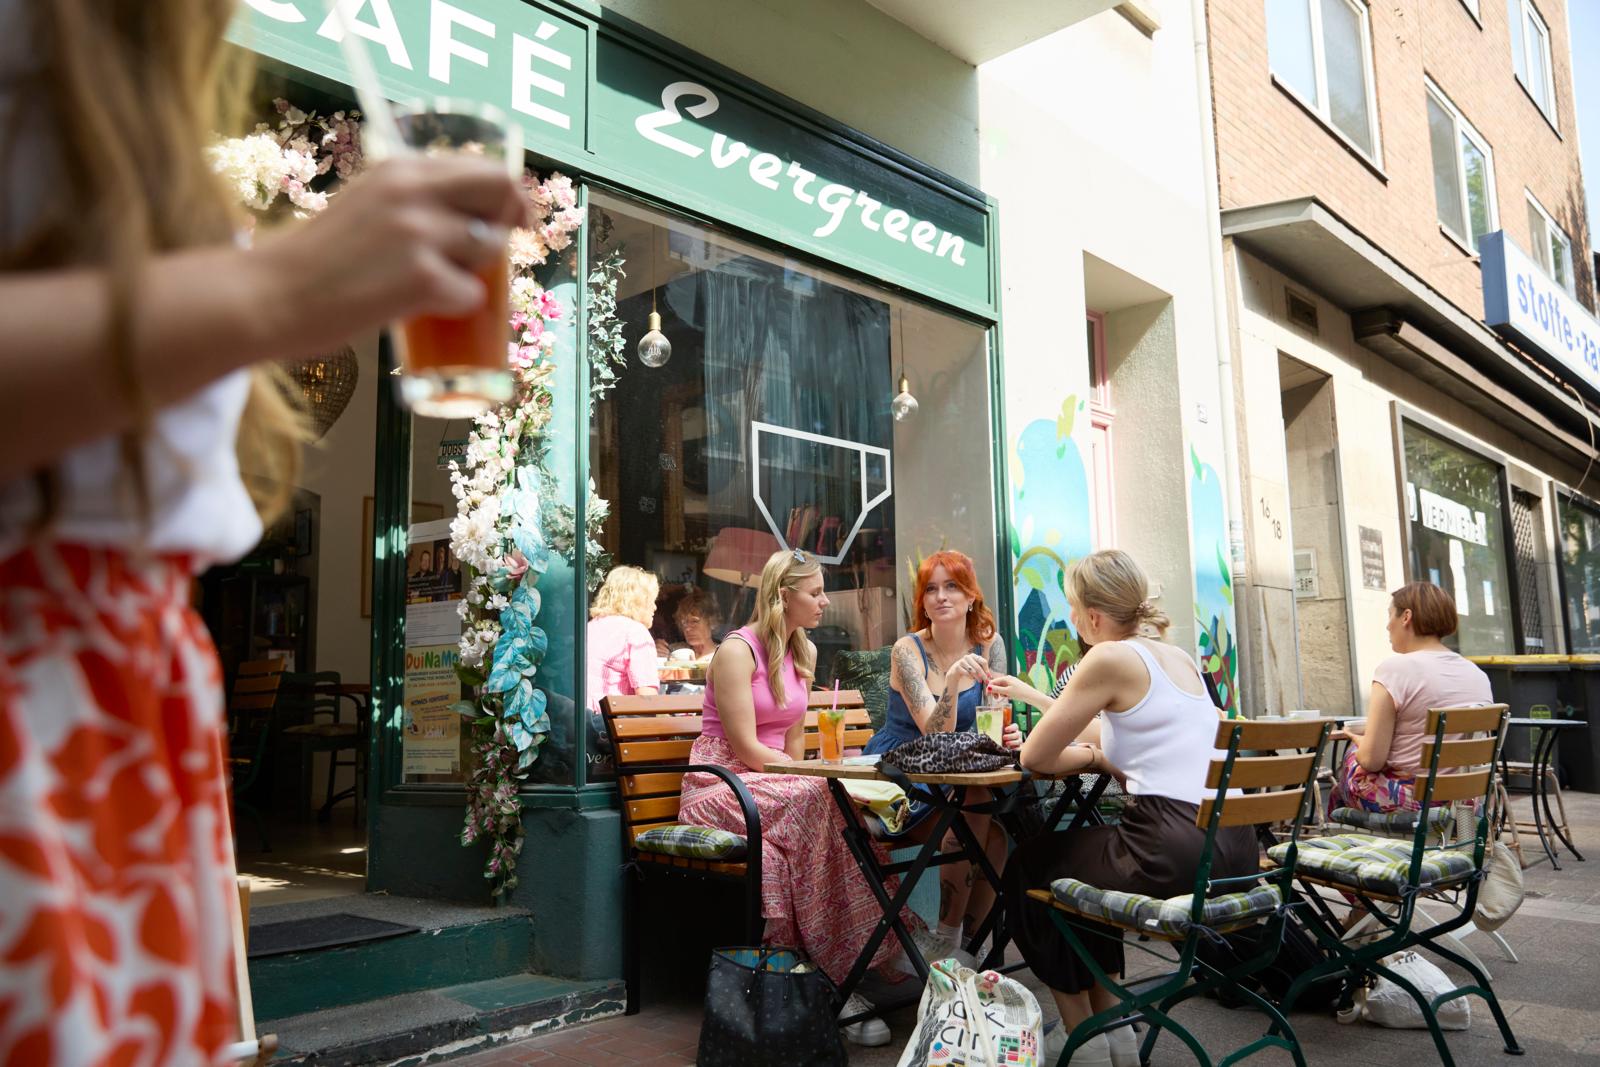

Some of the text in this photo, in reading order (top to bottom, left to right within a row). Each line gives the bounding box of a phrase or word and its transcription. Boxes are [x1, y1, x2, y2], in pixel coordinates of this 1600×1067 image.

[635, 81, 966, 266] Evergreen
[442, 443, 463, 456] DOGS
[1260, 497, 1271, 519] 16
[1272, 519, 1282, 540] 18
